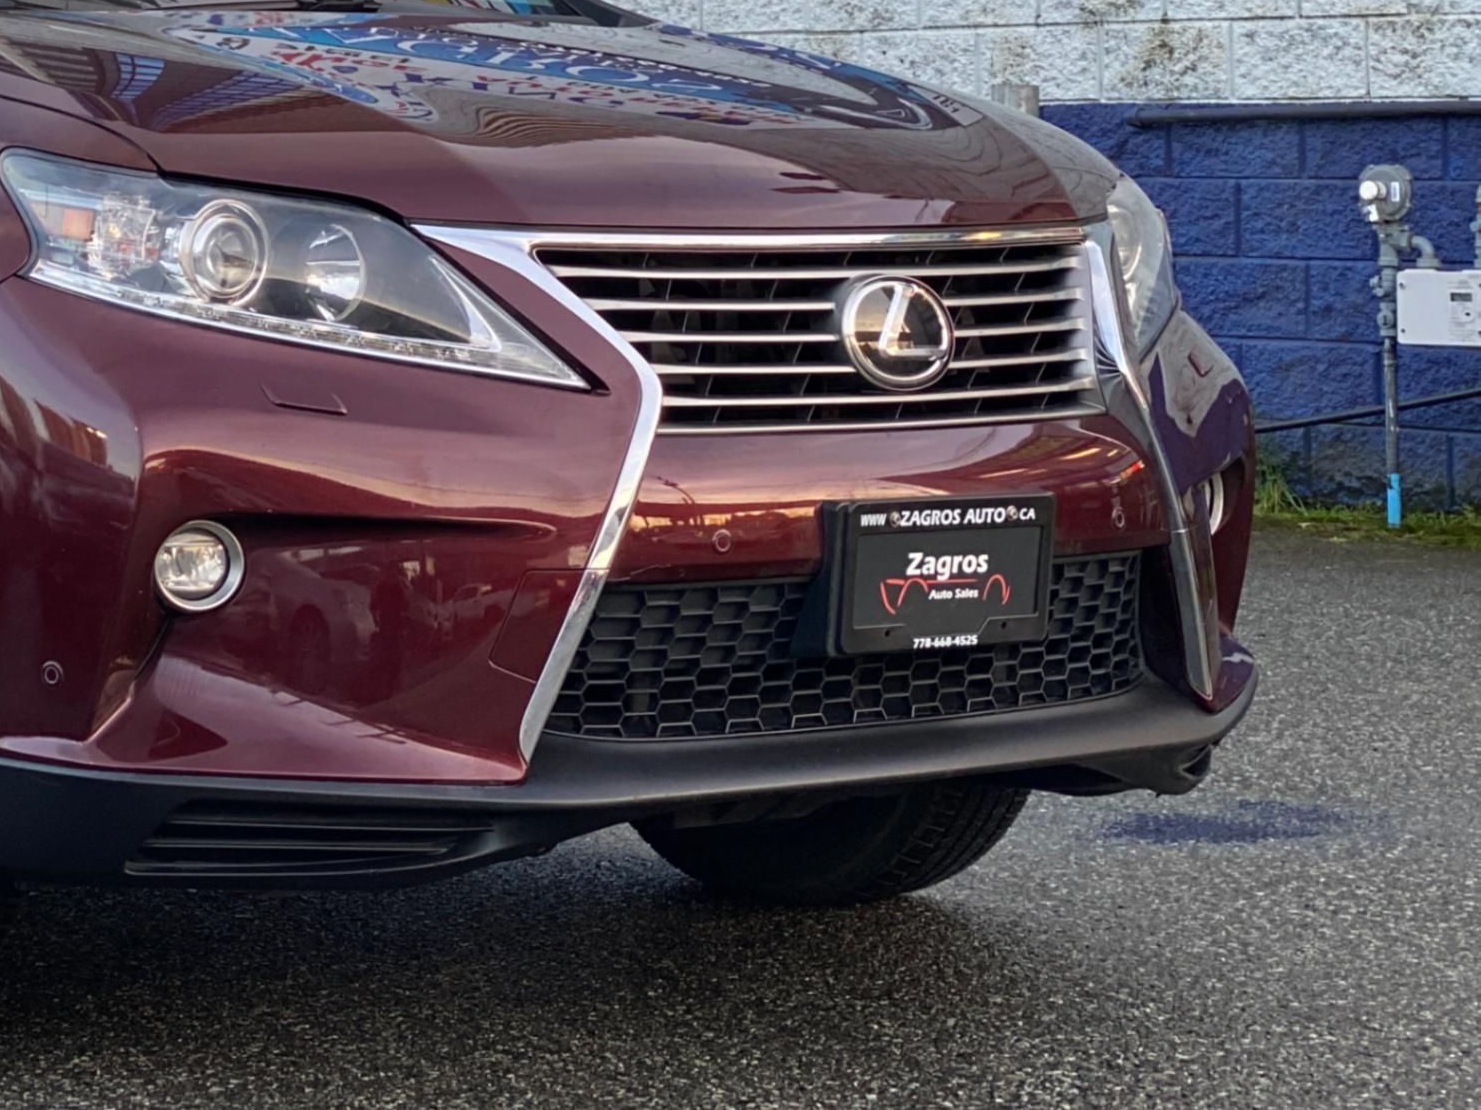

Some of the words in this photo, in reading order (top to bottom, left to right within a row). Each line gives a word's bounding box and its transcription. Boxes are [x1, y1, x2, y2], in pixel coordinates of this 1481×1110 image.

[860, 513, 888, 527] WWW
[900, 508, 961, 527] ZAGROS
[963, 507, 1007, 525] AUTO
[905, 552, 989, 582] Zagros
[928, 589, 953, 601] Auto
[954, 587, 979, 599] Sales
